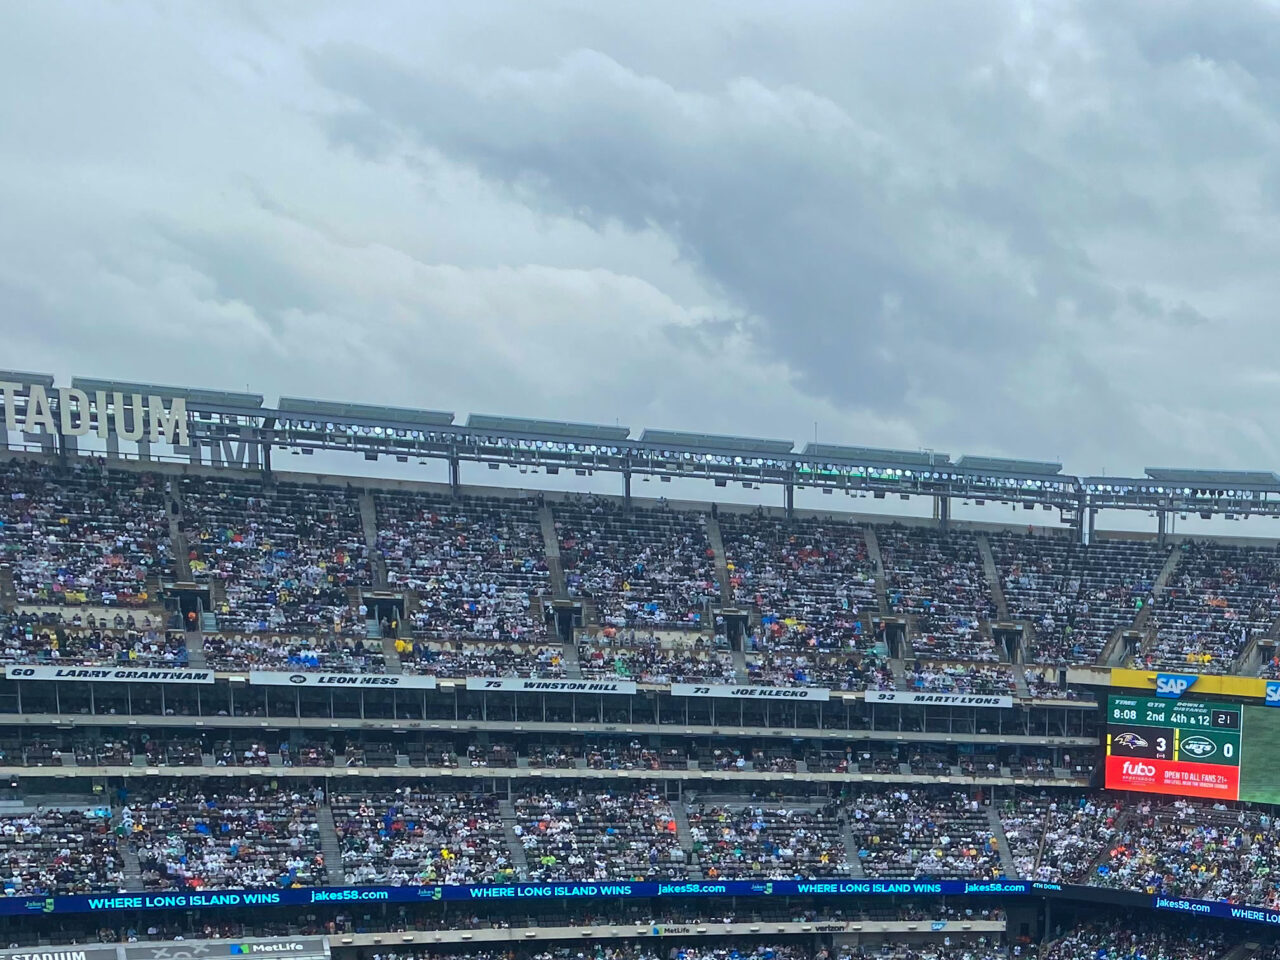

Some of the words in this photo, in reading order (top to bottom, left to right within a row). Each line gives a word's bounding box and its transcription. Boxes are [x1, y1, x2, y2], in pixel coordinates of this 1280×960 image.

[11, 668, 35, 676] 60
[56, 670, 111, 678] LARRY
[114, 671, 209, 680] GRANTHAM
[318, 676, 358, 685] LEON
[360, 677, 400, 686] HESS
[1156, 678, 1188, 694] SAP
[524, 682, 586, 690] WINSTON
[588, 683, 618, 692] HILL
[731, 688, 755, 696] JOE
[756, 688, 808, 698] KLECKO
[914, 695, 958, 704] MARTY
[958, 697, 1000, 706] LYONS
[1114, 710, 1136, 720] 8:08
[1146, 712, 1164, 722] 2nd
[1170, 713, 1187, 723] 4th
[1198, 716, 1210, 726] 12
[1218, 714, 1230, 724] 21
[1156, 738, 1166, 752] 3
[1224, 744, 1234, 758] 0
[1122, 761, 1156, 776] fubo
[1164, 770, 1180, 778] OPEN
[469, 886, 515, 898] WHERE
[516, 886, 552, 897] LONG
[554, 886, 597, 896] ISLAND
[599, 884, 632, 896] WINS
[658, 883, 726, 896] jakes58.com
[798, 884, 838, 894] WHERE
[839, 884, 870, 894] LONG
[872, 884, 910, 894] ISLAND
[912, 884, 942, 894] WINS
[964, 882, 1026, 893] jakes58.com
[88, 898, 142, 910] WHERE
[146, 896, 186, 907] LONG
[189, 894, 241, 906] ISLAND
[243, 892, 280, 904] WINS
[310, 889, 388, 904] jakes58.com
[1156, 896, 1211, 913] jakes58.com
[1231, 908, 1264, 922] WHERE
[664, 928, 690, 936] MetLife
[815, 924, 845, 934] verizon
[253, 944, 304, 953] MetLife
